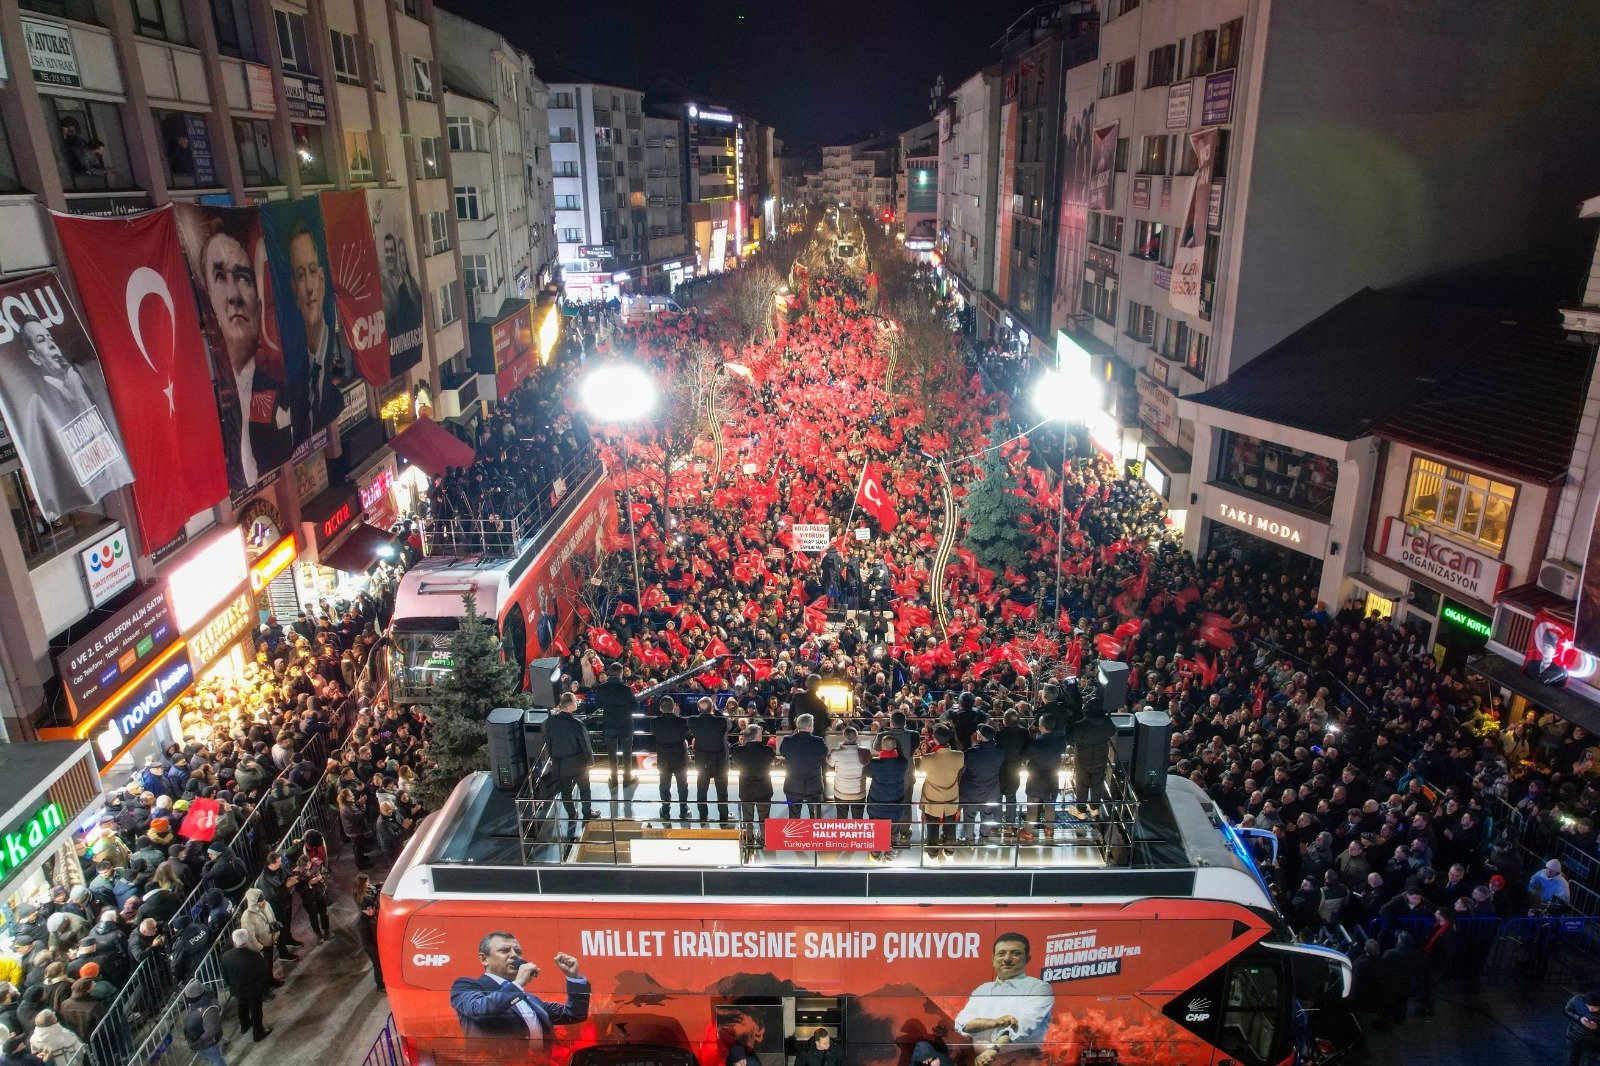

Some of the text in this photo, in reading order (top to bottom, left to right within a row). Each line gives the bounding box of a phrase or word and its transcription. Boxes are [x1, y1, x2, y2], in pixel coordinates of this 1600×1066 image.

[35, 32, 71, 55] AVUKAT
[352, 310, 386, 351] CHP
[1220, 503, 1301, 543] TAKI MODA
[1402, 550, 1478, 592] ORGANİZASYON
[1444, 607, 1467, 624] OKAY
[77, 653, 88, 665] VE
[95, 642, 104, 652] EL
[103, 618, 132, 645] TELEFON
[132, 608, 147, 624] ALIM
[105, 646, 120, 660] Tablet
[73, 674, 84, 686] Cep
[812, 821, 875, 830] CUMHURİYET
[812, 830, 875, 839] HALK PARTİSİ
[783, 840, 825, 849] Türkiye'nin
[825, 840, 848, 848] Birinci
[580, 929, 980, 963] MİLLET İRADESİNE SAHİP ÇIKIYOR
[1046, 935, 1097, 954] EKREM
[412, 953, 451, 967] CHP
[1044, 944, 1141, 968] İMAMOĞLU'NA
[1043, 960, 1118, 982] ÖZGÜRLÜK
[1185, 1013, 1210, 1022] CHP
